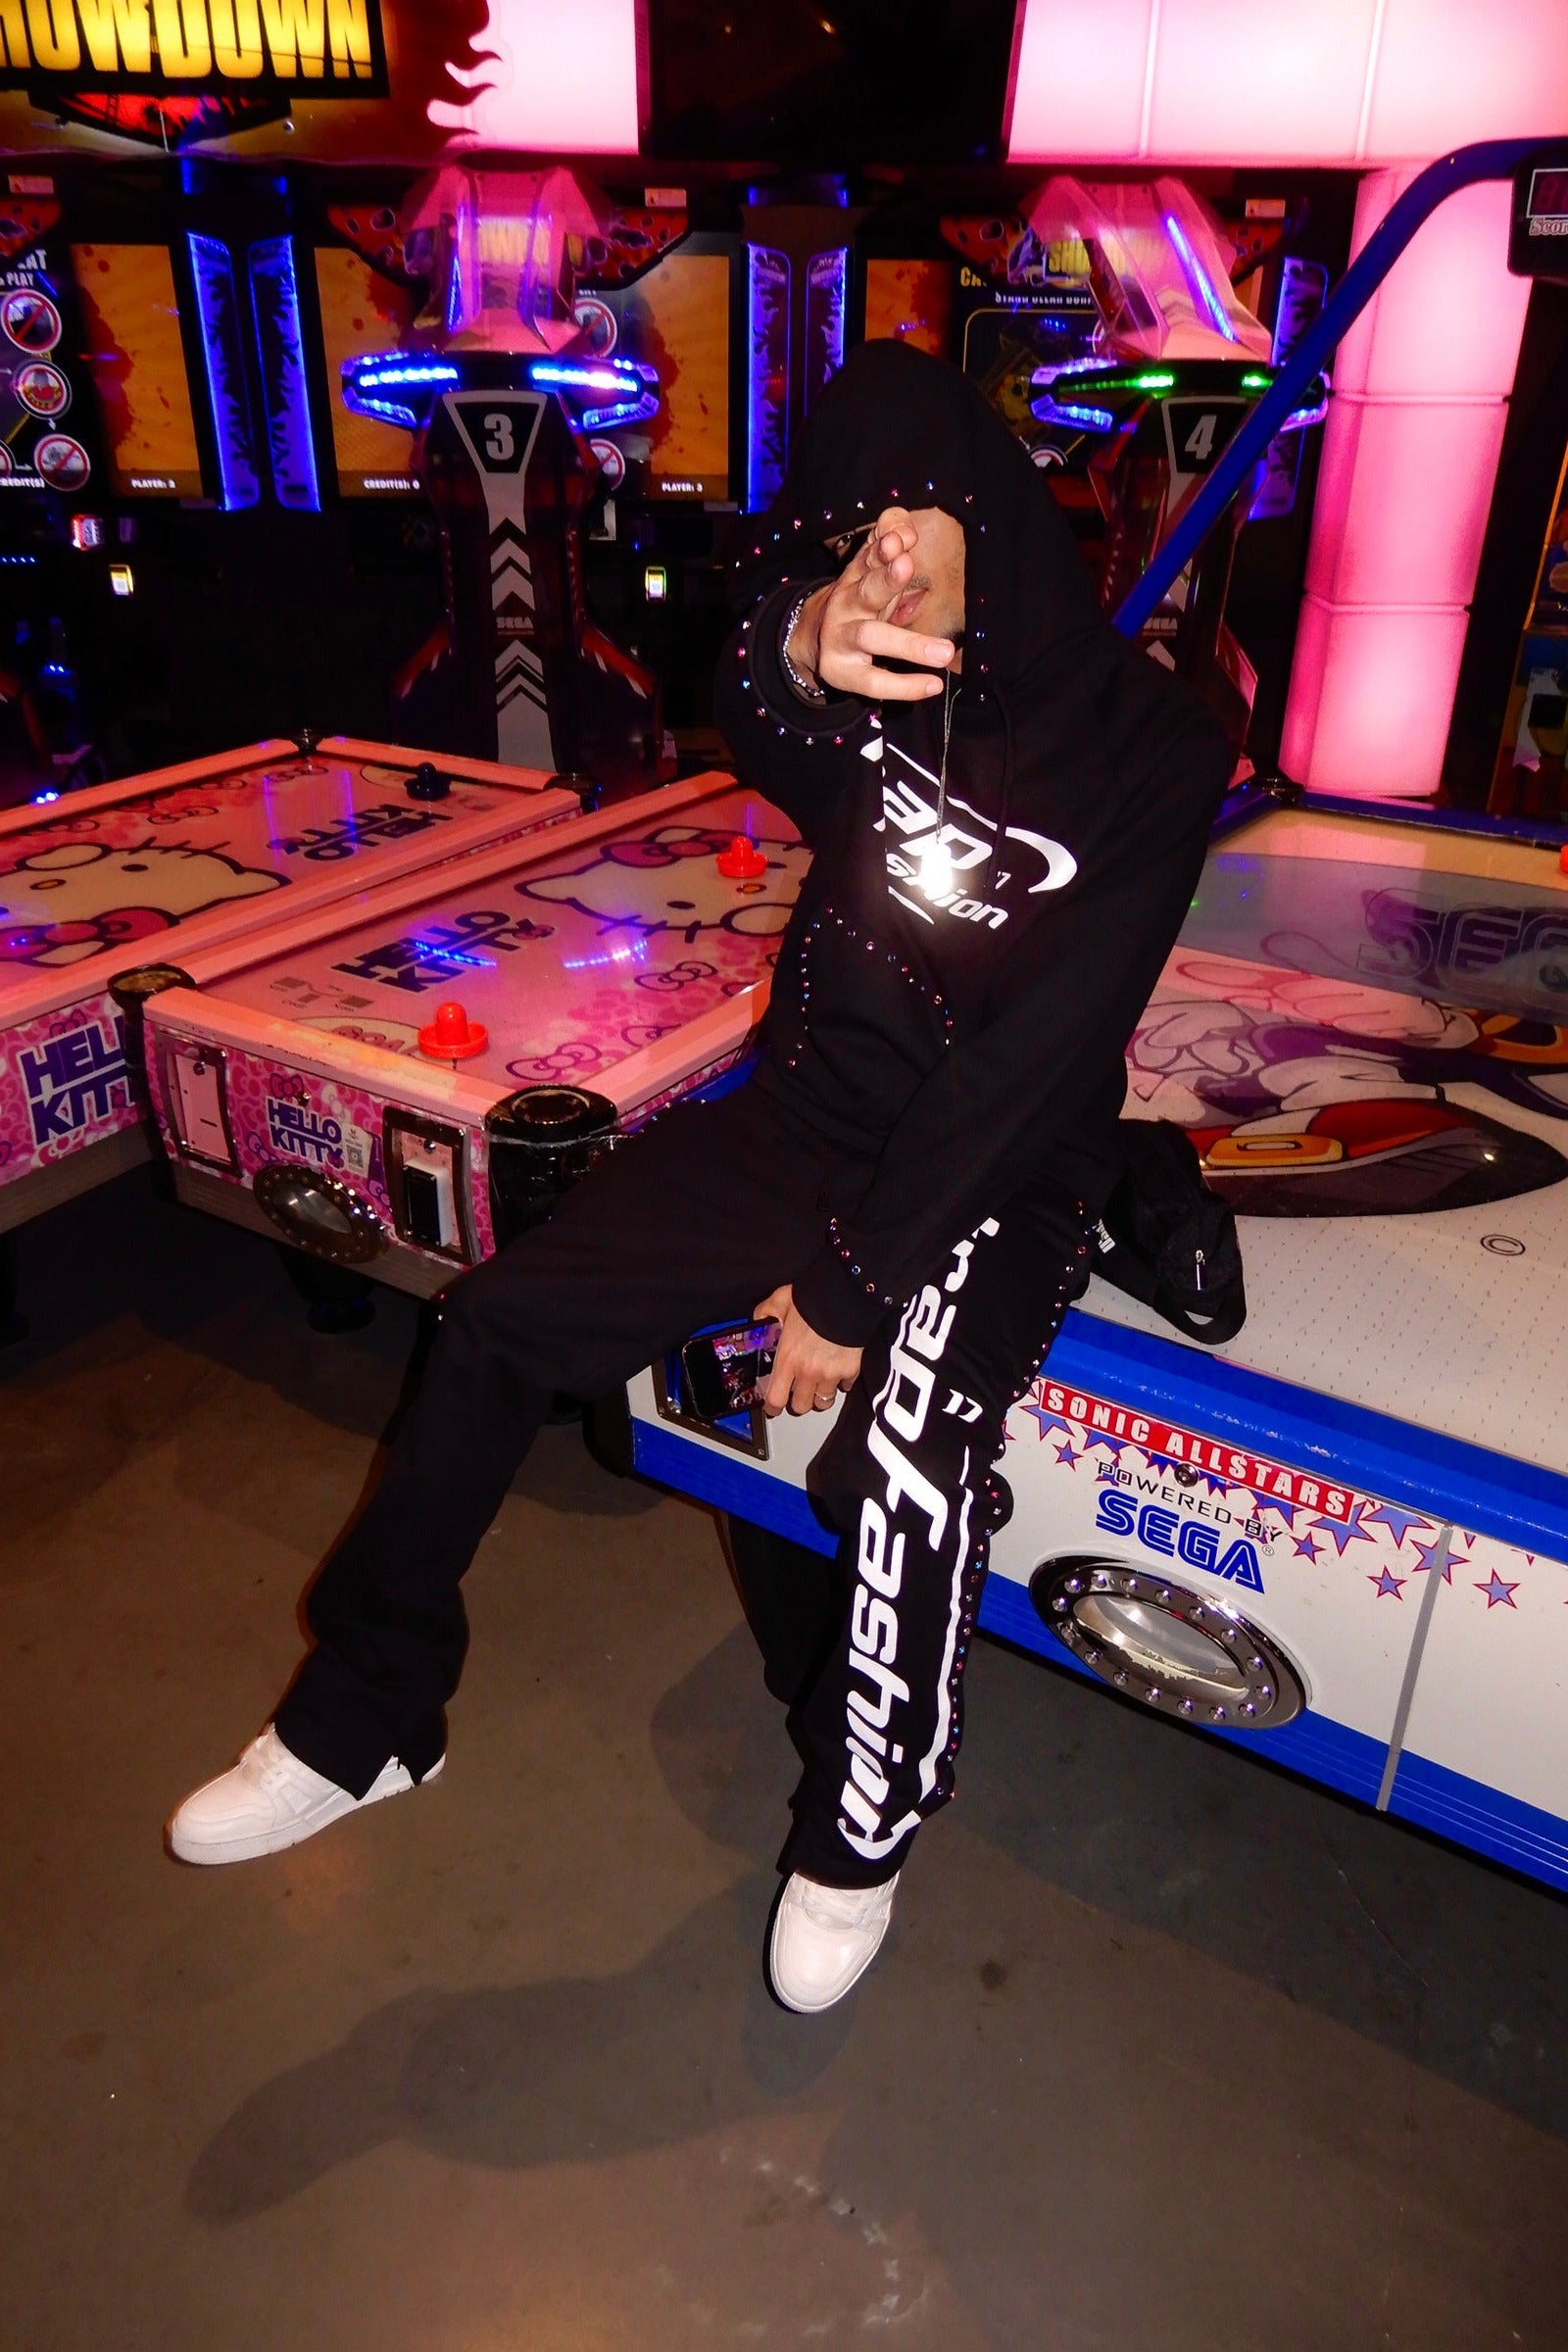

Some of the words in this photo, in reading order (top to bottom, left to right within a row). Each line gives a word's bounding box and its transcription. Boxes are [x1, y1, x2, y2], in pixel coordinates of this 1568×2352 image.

[484, 413, 514, 460] 3
[1185, 415, 1217, 460] 4
[0, 477, 45, 488] REDIT(S)
[496, 616, 534, 629] SEGA
[267, 1098, 342, 1145] HELLO
[270, 1123, 344, 1169] KITTY
[1048, 1387, 1151, 1443] SONIC
[1164, 1432, 1347, 1516] ALLSTARS
[1098, 1461, 1232, 1524] POWERED
[1244, 1518, 1284, 1542] BY
[1095, 1489, 1266, 1594] SEGA
